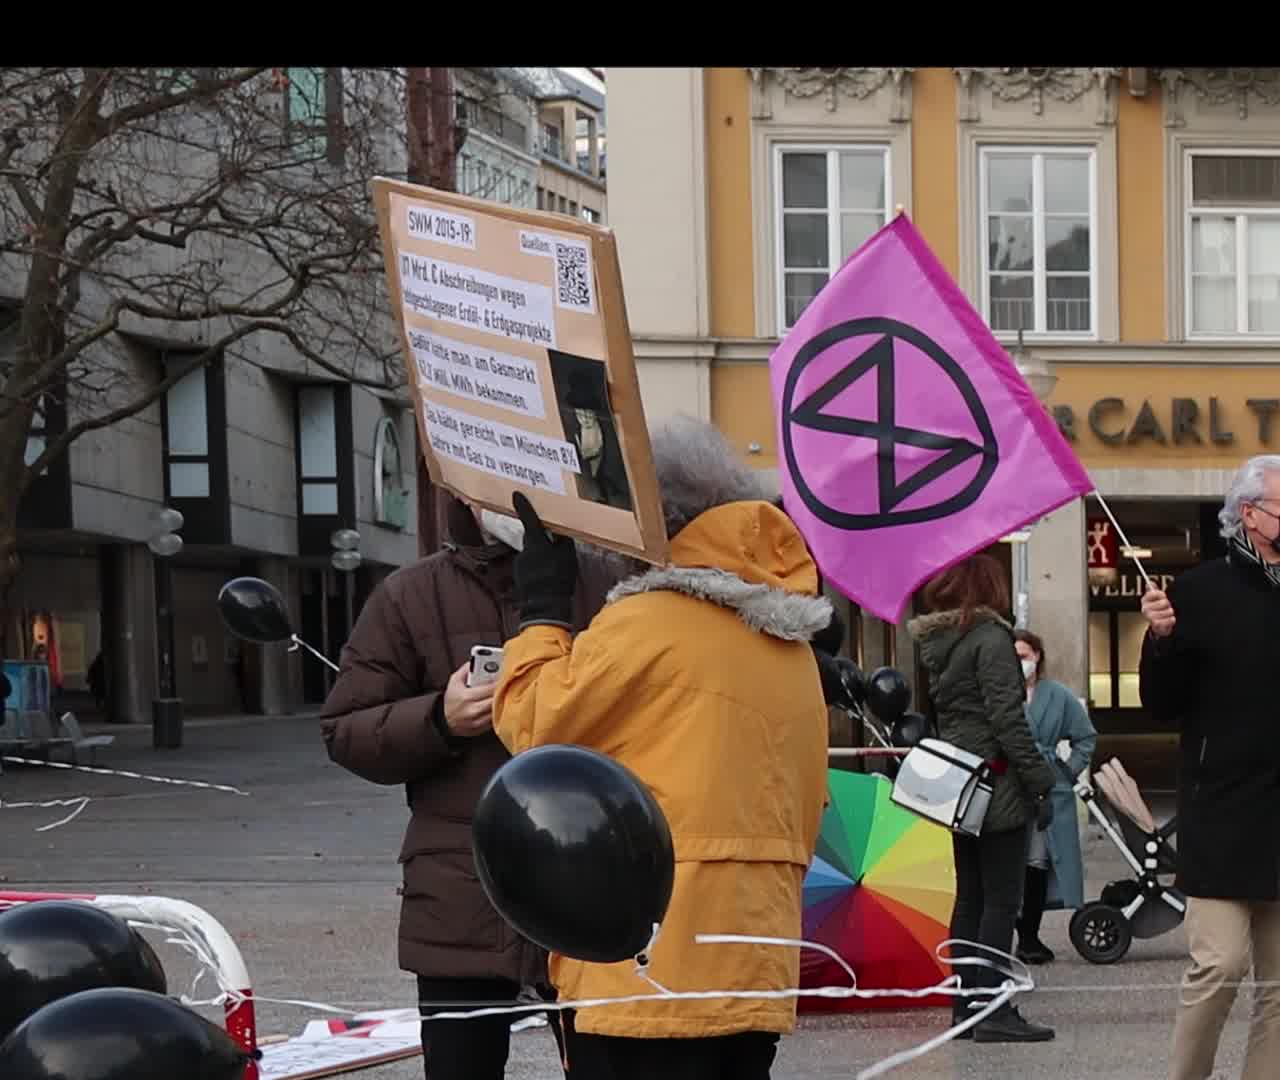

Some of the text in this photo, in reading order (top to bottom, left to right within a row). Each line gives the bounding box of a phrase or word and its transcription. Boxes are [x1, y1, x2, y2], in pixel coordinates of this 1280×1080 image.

[409, 211, 432, 234] SWM
[440, 269, 498, 302] Abschreibungen
[501, 288, 527, 310] wegen
[492, 310, 552, 343] Erdgasprojekte
[452, 350, 472, 368] man
[475, 357, 490, 372] am
[490, 357, 537, 384] Gasmarkt
[451, 372, 473, 394] MWh
[475, 380, 529, 410] bekommen.
[1088, 397, 1233, 446] CARL
[452, 443, 464, 459] mit
[466, 446, 483, 467] Gas
[485, 455, 496, 470] zu
[498, 461, 548, 486] versorgen.
[501, 434, 514, 449] um
[515, 434, 560, 464] München
